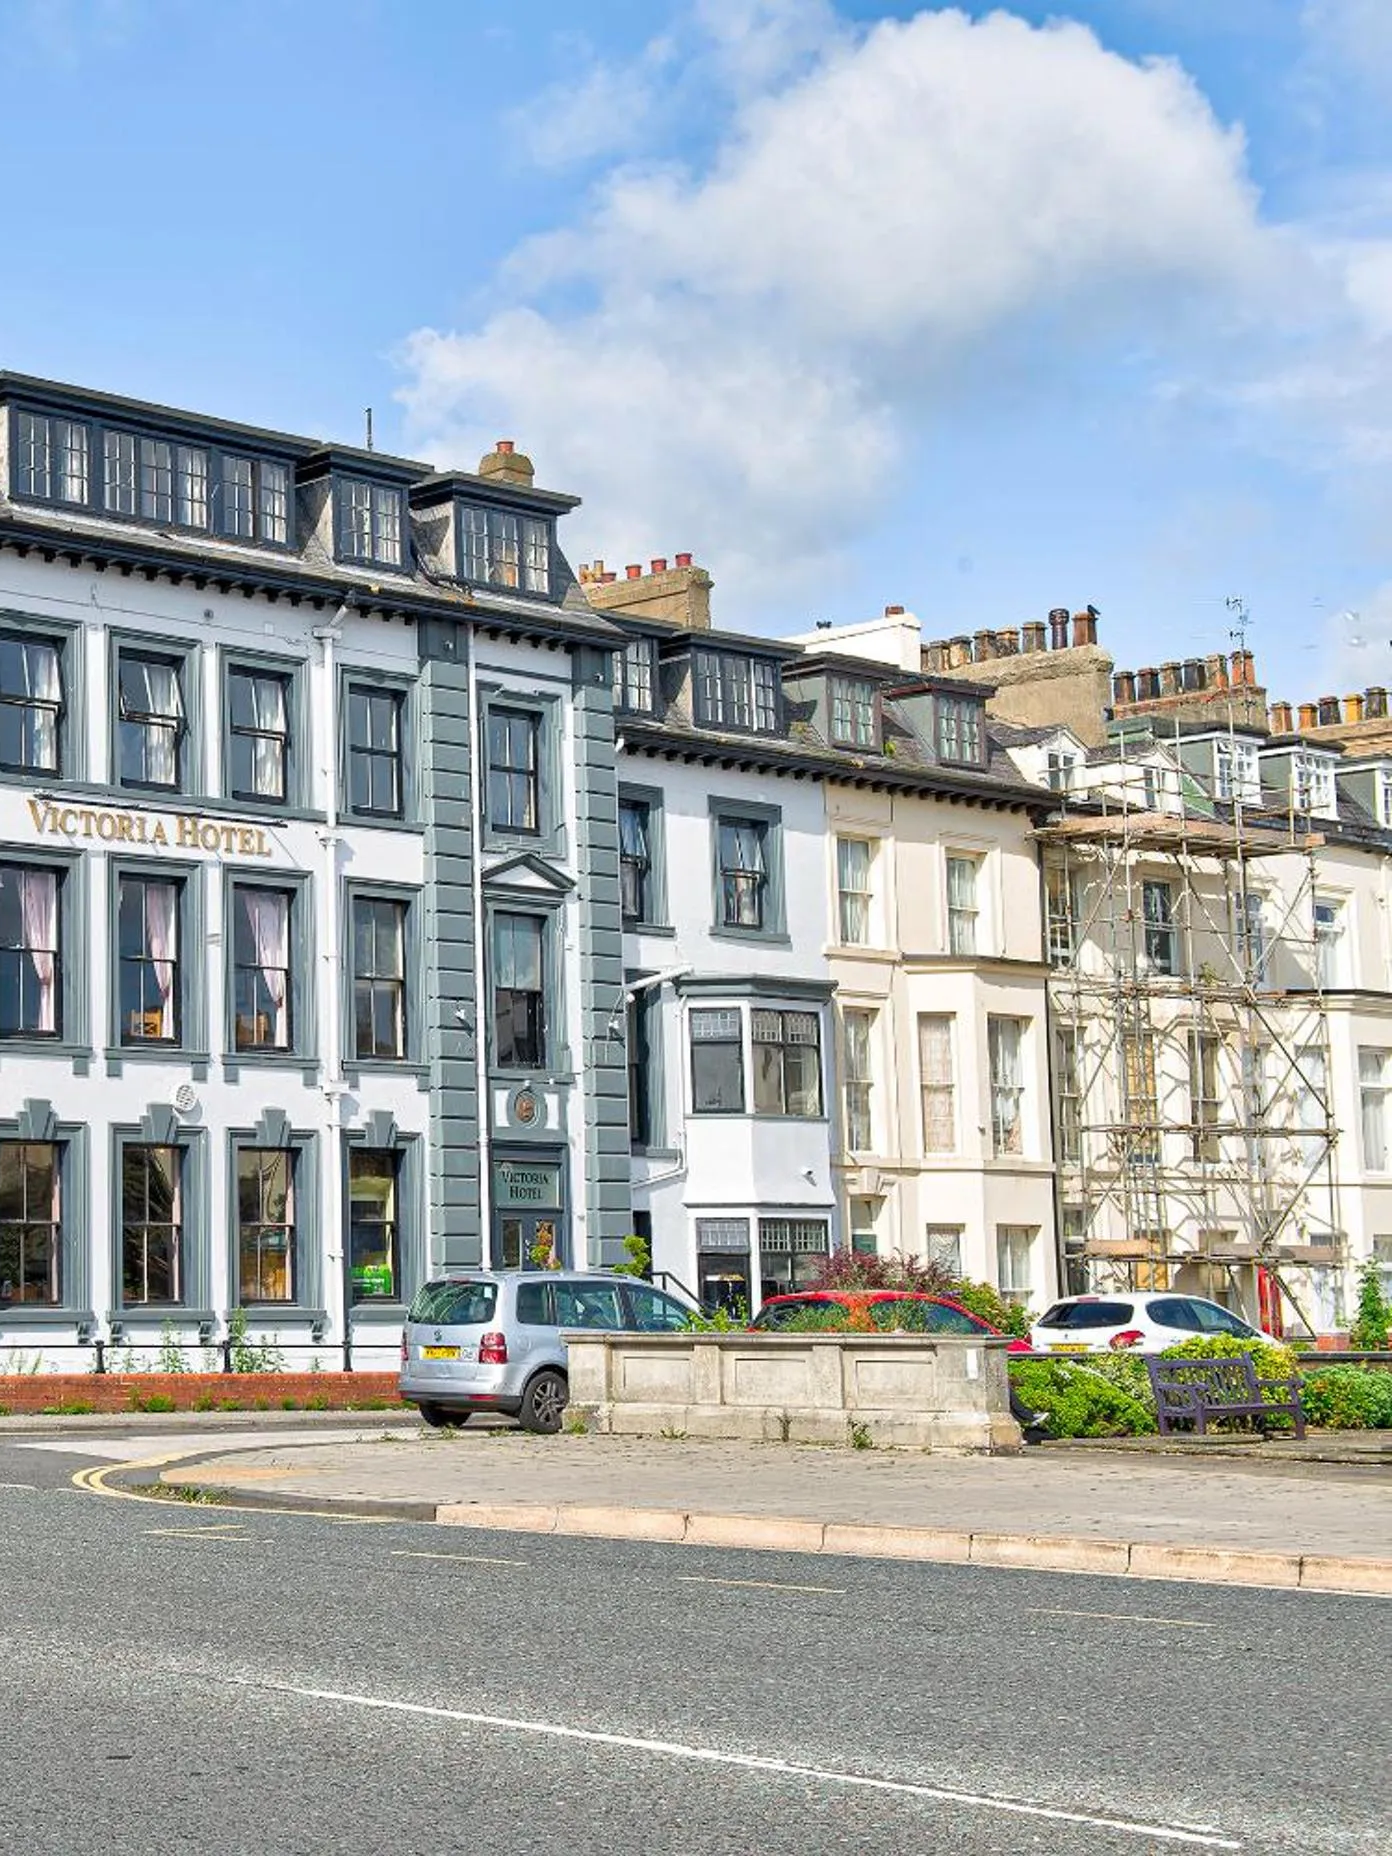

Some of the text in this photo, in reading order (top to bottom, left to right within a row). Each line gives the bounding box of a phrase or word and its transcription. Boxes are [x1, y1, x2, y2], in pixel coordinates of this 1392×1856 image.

[26, 799, 273, 857] VICTORIA HOTEL
[502, 1170, 551, 1185] VICTORIA
[510, 1186, 543, 1200] HOTEL
